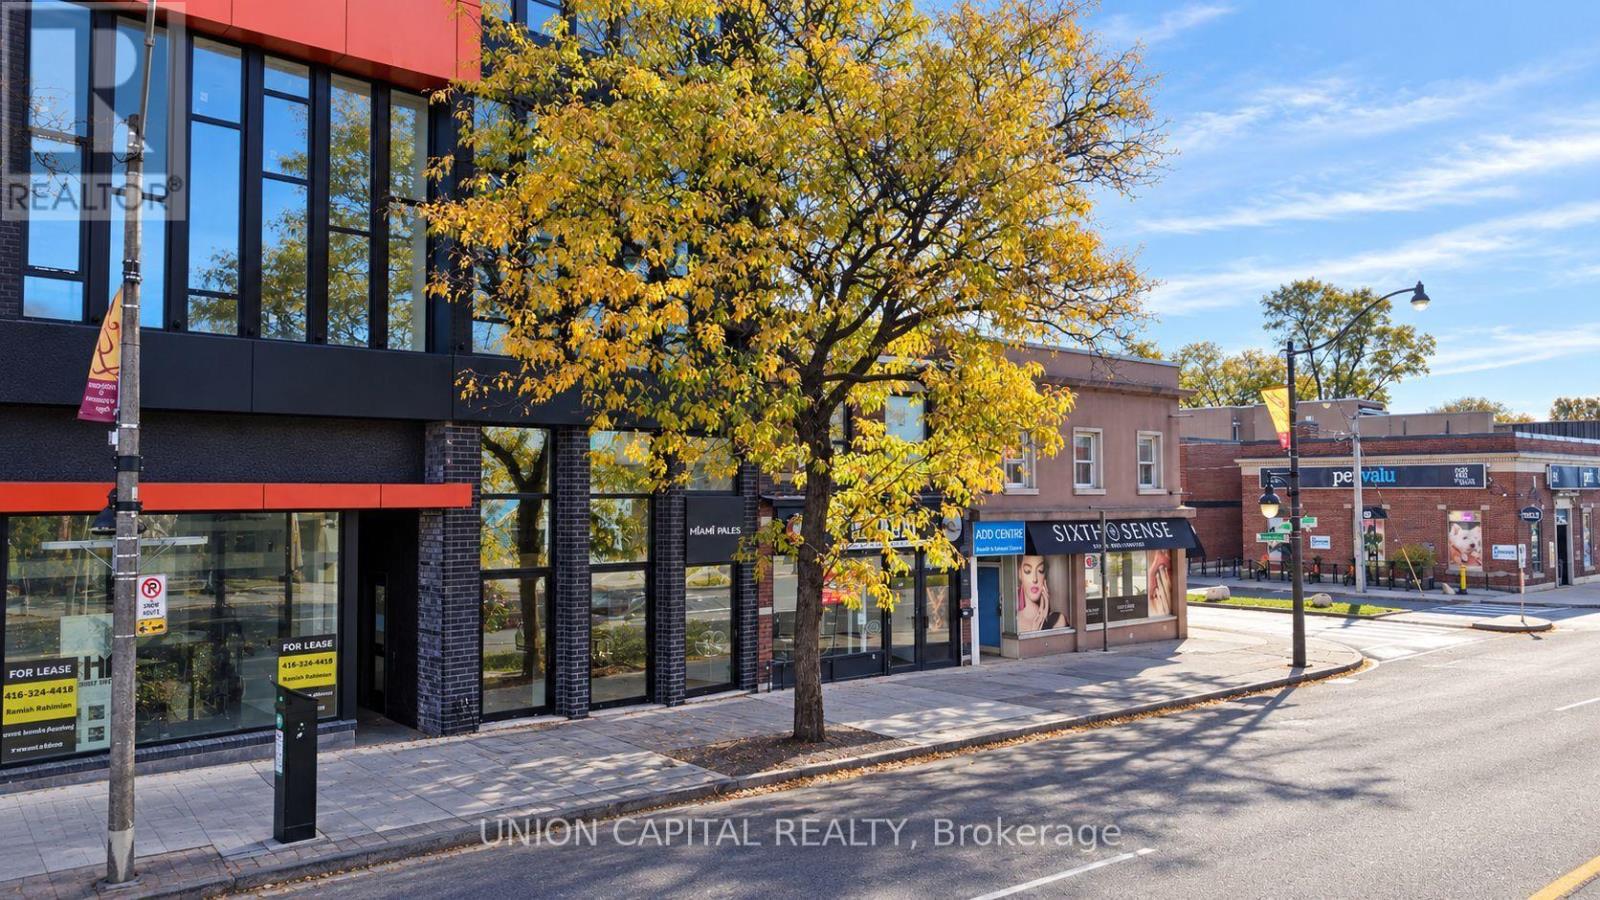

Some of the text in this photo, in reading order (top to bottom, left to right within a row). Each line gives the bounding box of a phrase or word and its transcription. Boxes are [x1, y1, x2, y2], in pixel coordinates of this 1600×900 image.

[995, 528, 1024, 539] CENTRE
[1052, 521, 1173, 542] SIXTH SENSE
[282, 639, 333, 652] FOR LEASE
[9, 664, 72, 679] FOR LEASE
[4, 685, 74, 700] 416-324-4418
